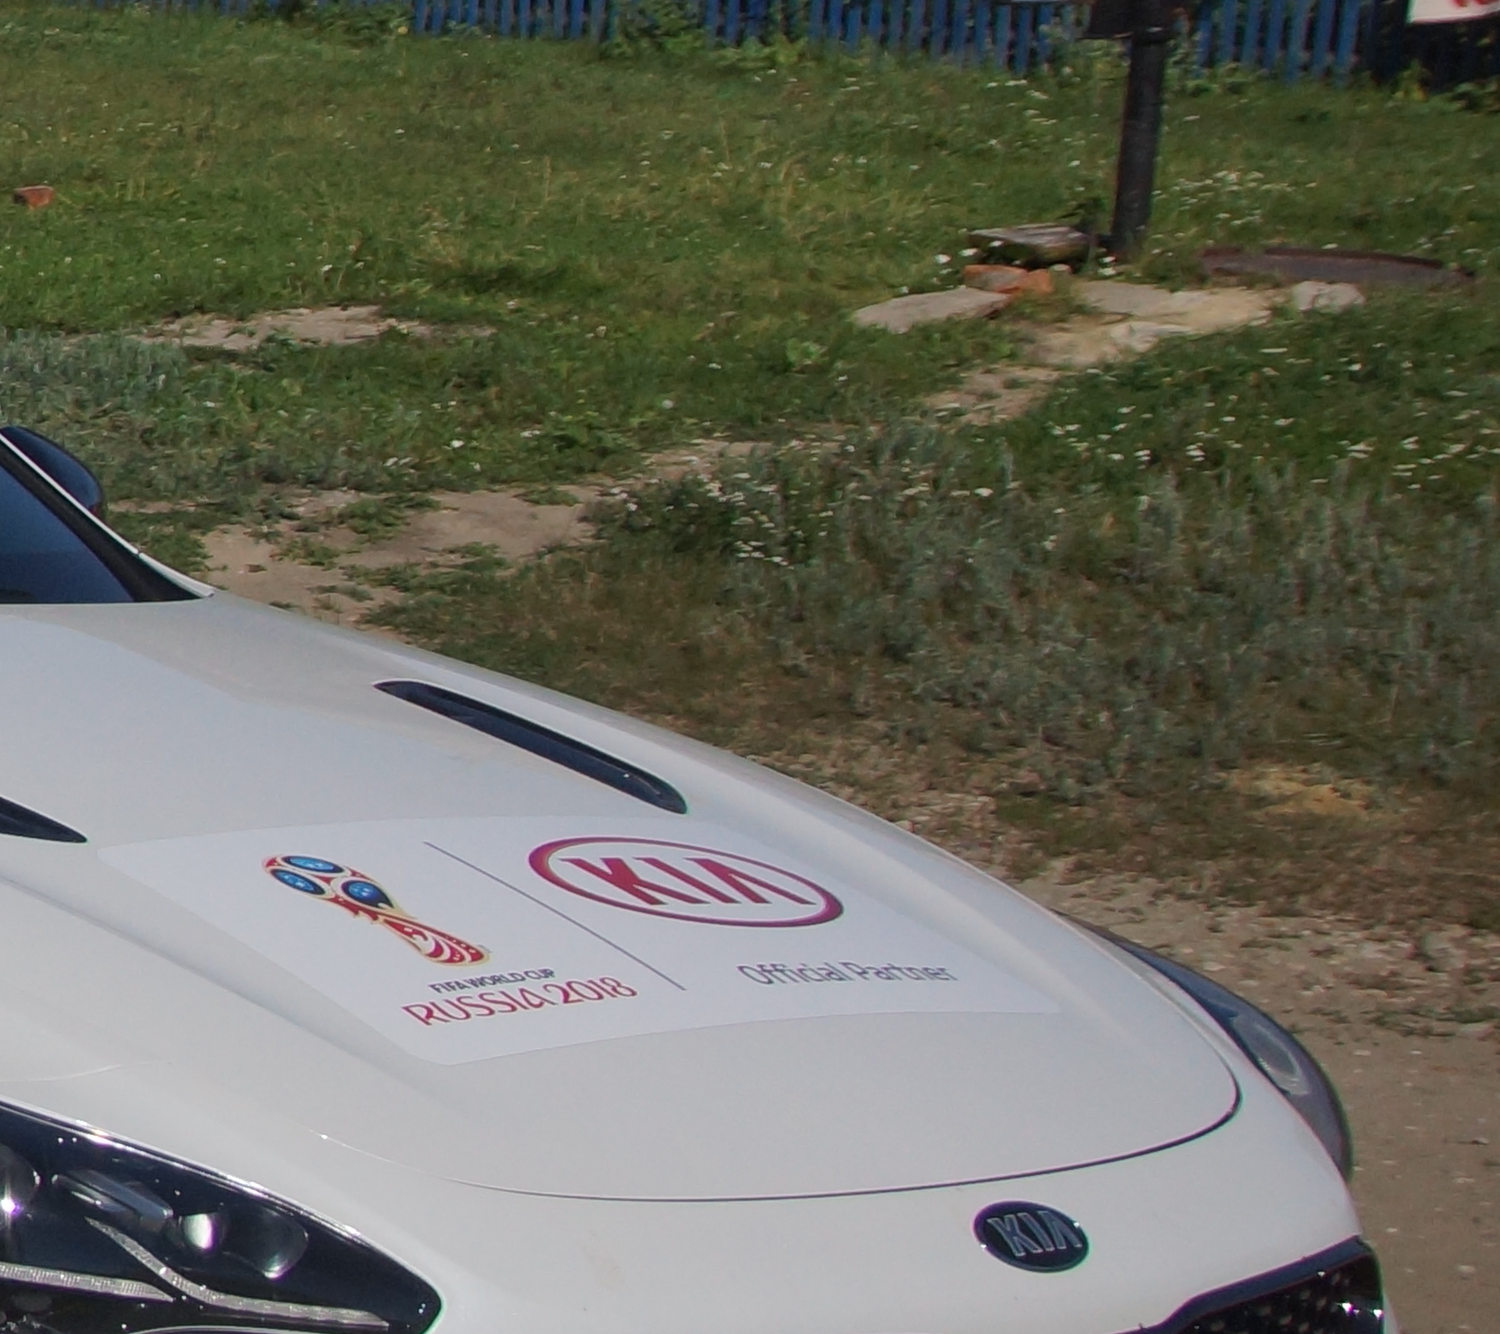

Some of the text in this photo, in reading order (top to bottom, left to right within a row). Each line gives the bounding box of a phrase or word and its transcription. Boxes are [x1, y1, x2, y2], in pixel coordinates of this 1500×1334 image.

[557, 857, 816, 905] KIA
[428, 968, 557, 994] FIFA WORLD CUP
[737, 961, 958, 985] Official Partner
[401, 977, 638, 1026] RUSSIA 2018
[986, 1210, 1083, 1256] KIA
